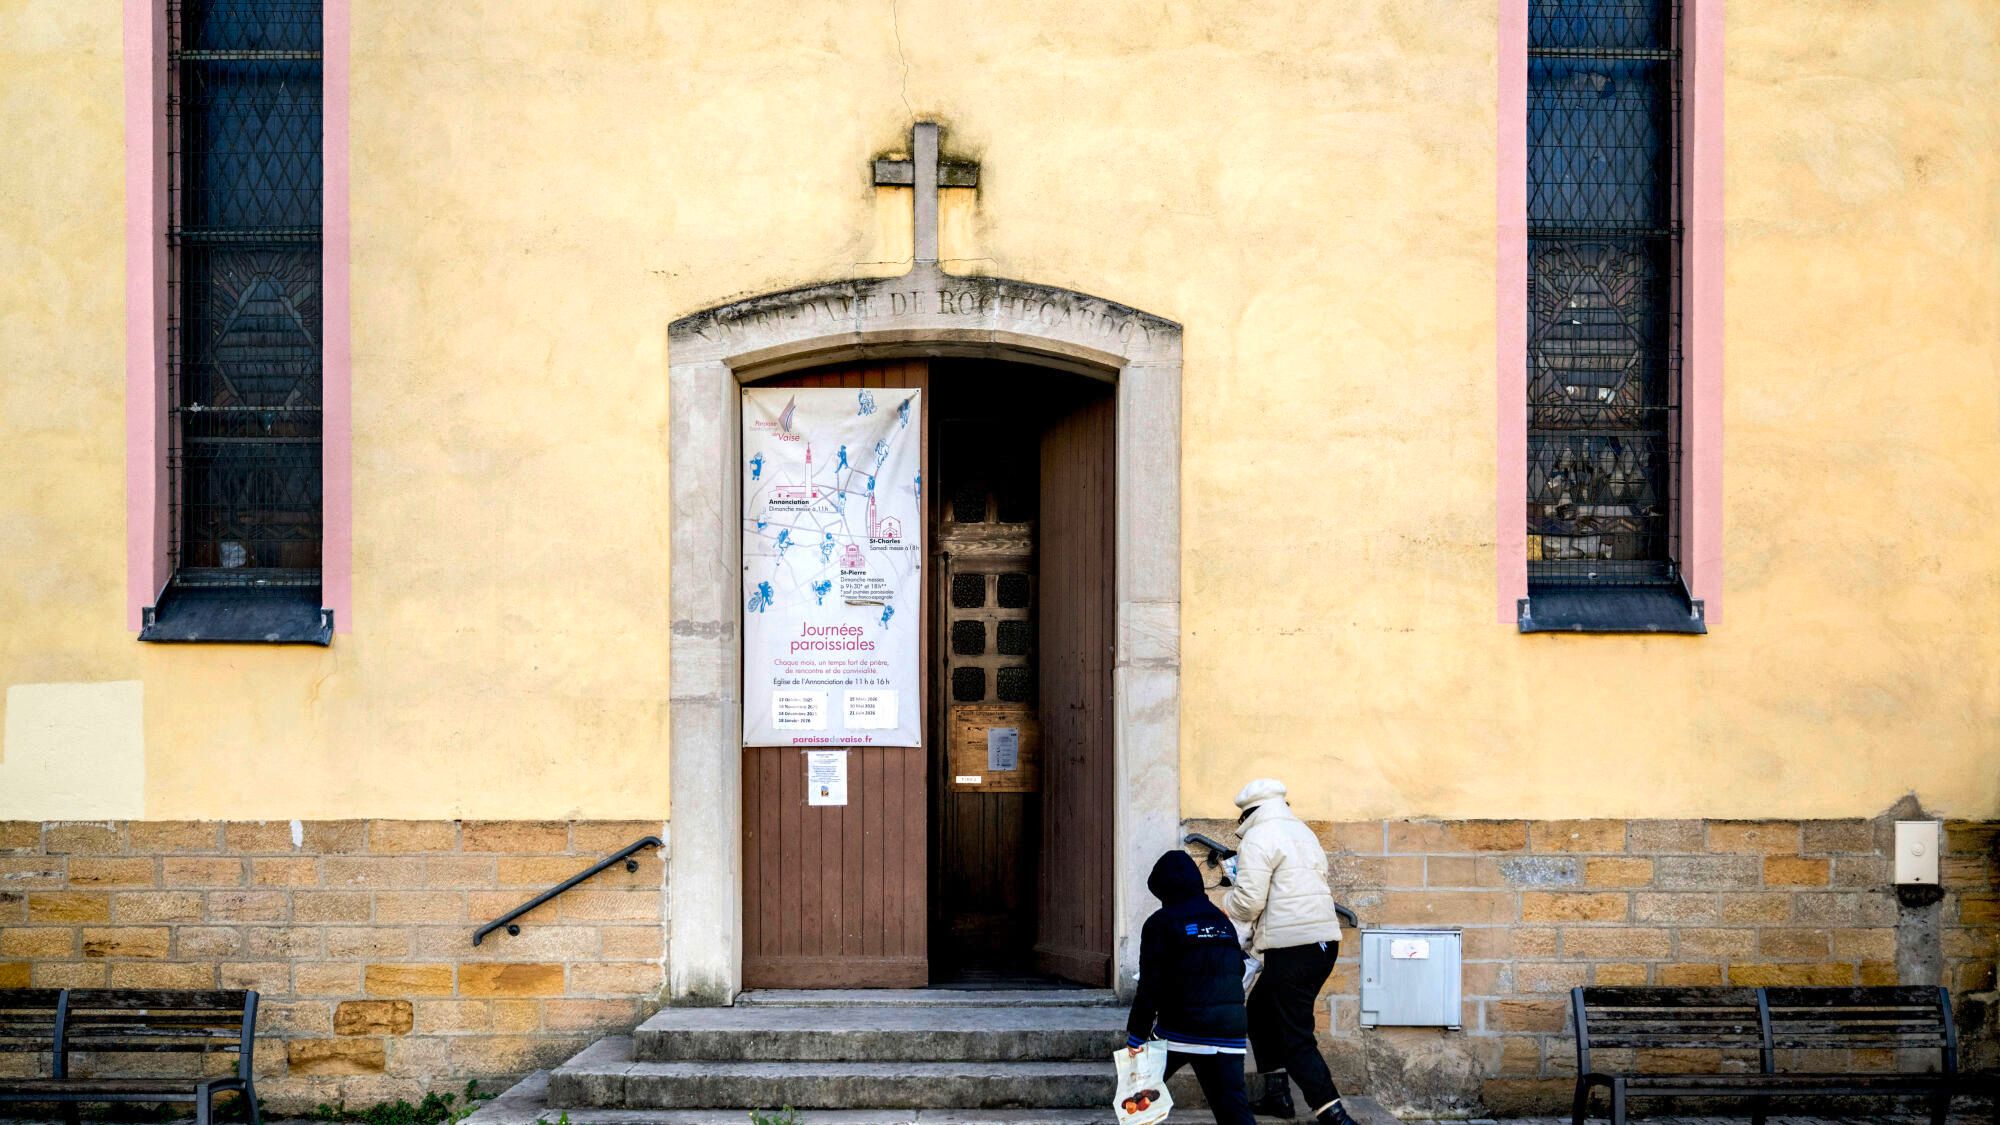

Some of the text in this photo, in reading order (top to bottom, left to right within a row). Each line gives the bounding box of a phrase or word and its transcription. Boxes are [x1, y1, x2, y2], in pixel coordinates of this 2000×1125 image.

[891, 290, 925, 316] DE
[778, 433, 800, 442] Vaise
[768, 505, 795, 513] Dimanche
[800, 621, 864, 637] Journées
[790, 636, 875, 655] paroissiales
[774, 659, 799, 669] Chaque
[800, 659, 817, 668] mois,
[827, 659, 846, 668] temps
[869, 659, 890, 669] prière,
[773, 678, 790, 687] Église
[792, 735, 873, 744] paroissedevaise.fr
